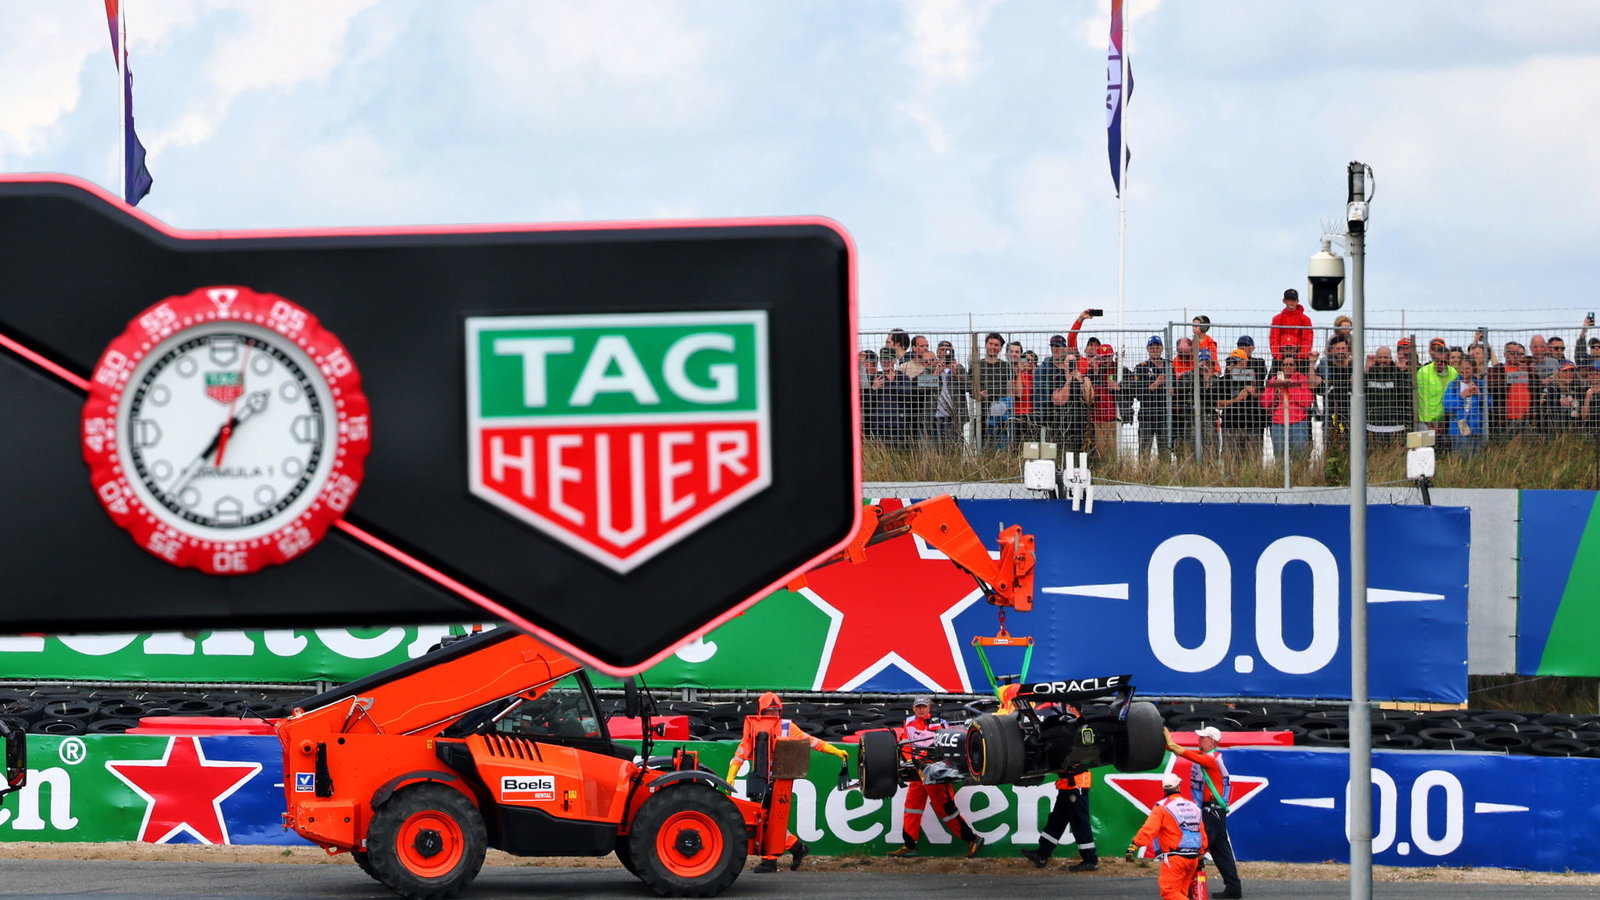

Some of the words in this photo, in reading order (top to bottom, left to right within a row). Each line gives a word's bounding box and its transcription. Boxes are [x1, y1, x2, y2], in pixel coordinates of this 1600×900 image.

[140, 303, 177, 335] 55
[270, 301, 307, 331] 05
[95, 350, 128, 388] 50
[326, 347, 352, 377] 10
[494, 332, 738, 407] TAG
[85, 417, 106, 453] 45
[350, 415, 368, 441] 15
[99, 481, 129, 514] 40
[326, 475, 357, 512] 20
[490, 430, 750, 548] HEUER
[147, 531, 183, 561] 35
[278, 528, 313, 559] 25
[213, 551, 248, 572] 30
[1148, 534, 1339, 674] 0.0
[1033, 676, 1120, 694] ORACLE
[504, 778, 552, 789] Boels
[1345, 768, 1463, 856] 0.0
